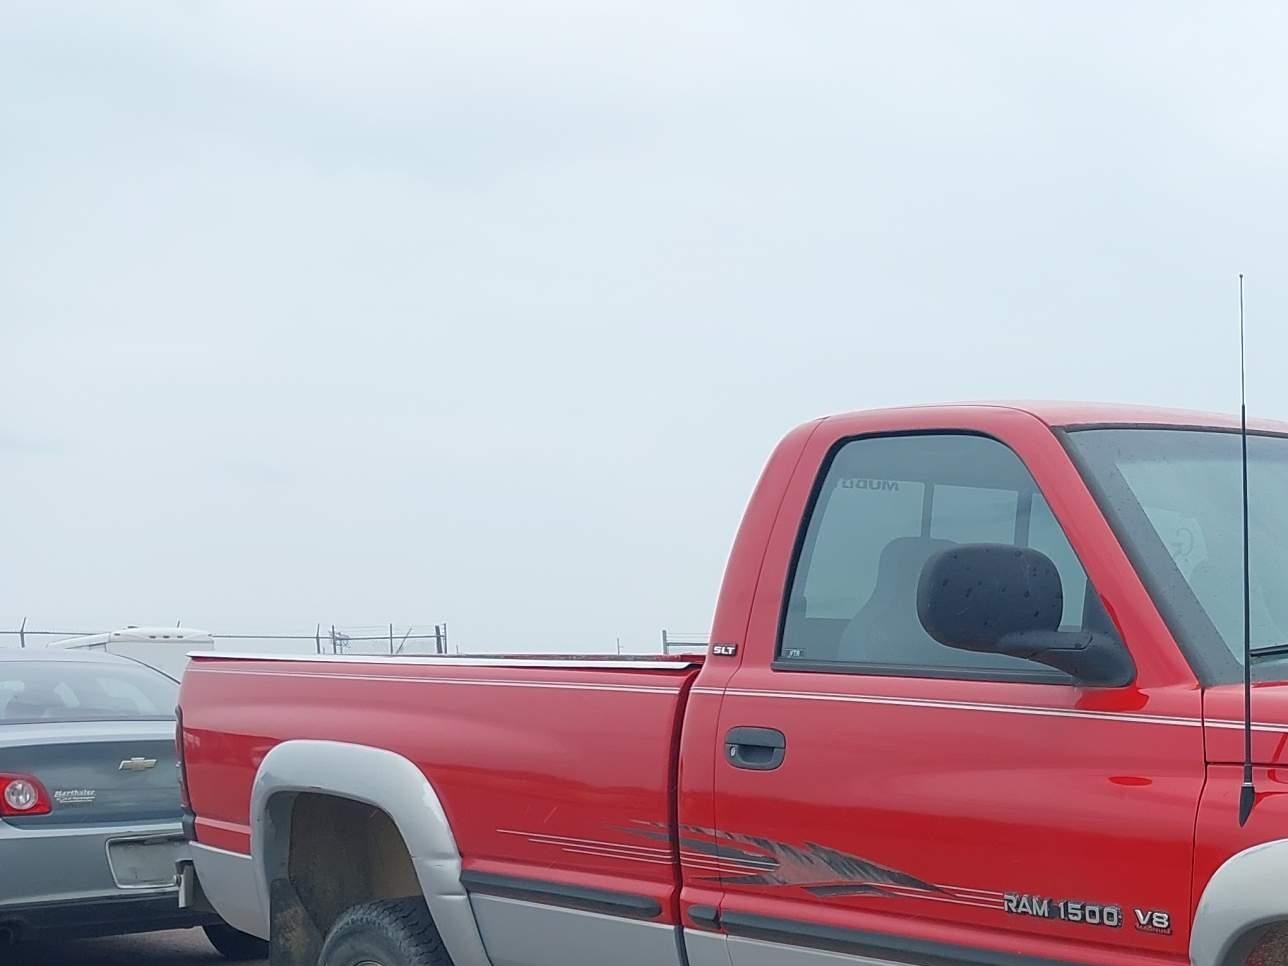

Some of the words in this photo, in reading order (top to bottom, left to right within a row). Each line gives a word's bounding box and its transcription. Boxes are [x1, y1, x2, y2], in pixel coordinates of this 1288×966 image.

[713, 645, 736, 655] SLT
[1003, 894, 1049, 917] RAM
[1058, 901, 1120, 927] 1500
[1135, 908, 1170, 929] V8
